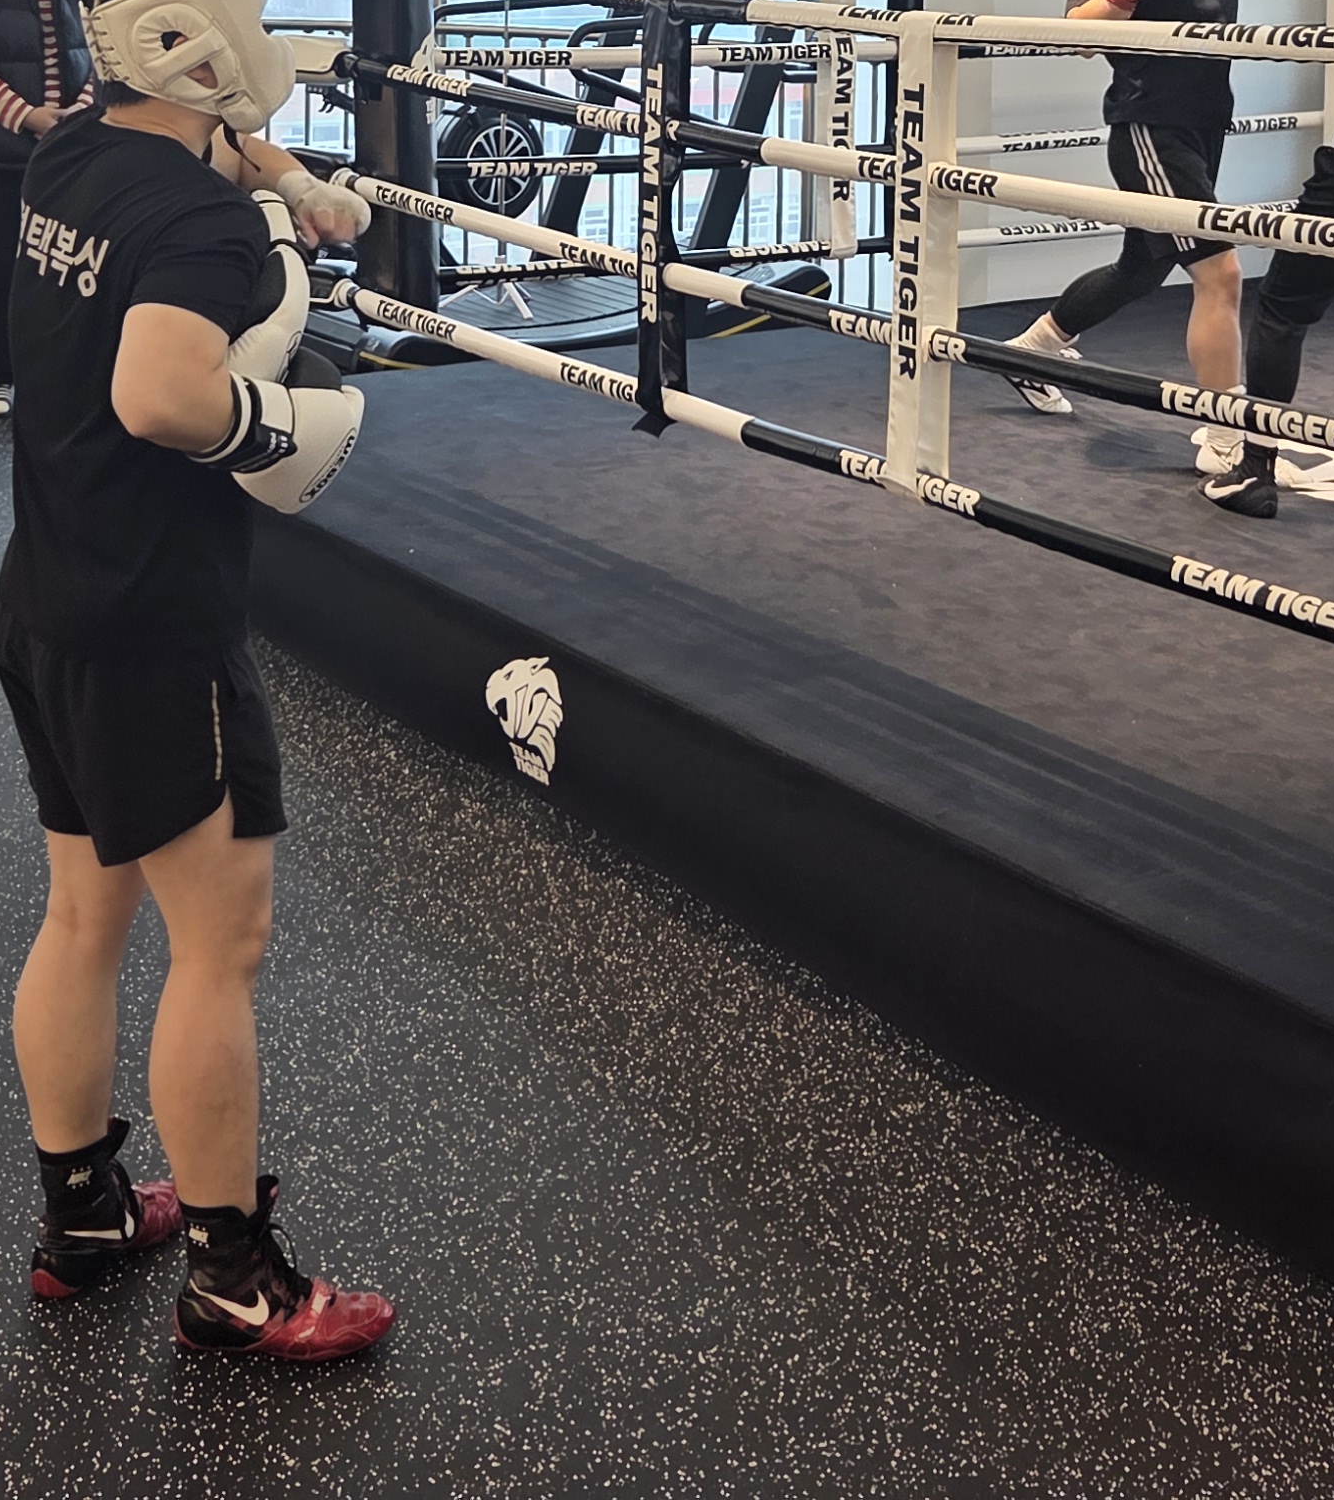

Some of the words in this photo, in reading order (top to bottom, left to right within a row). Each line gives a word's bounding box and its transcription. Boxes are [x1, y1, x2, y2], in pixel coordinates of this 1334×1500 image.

[442, 49, 505, 67] TEAM
[508, 49, 573, 67] TIGER
[718, 46, 773, 63] TEAM
[777, 43, 832, 61] TIGER
[833, 36, 854, 105] EAM
[386, 64, 430, 86] TEAM
[426, 72, 473, 97] TIGER
[576, 104, 627, 132] TEAM
[643, 63, 664, 186] TEAM
[1225, 120, 1252, 135] AM
[1255, 116, 1298, 133] TIGER
[467, 161, 533, 178] TEAM
[533, 161, 598, 177] TIGER
[857, 155, 896, 182] TEA
[899, 83, 925, 223] TEAM
[375, 184, 413, 215] TEAM
[414, 197, 455, 224] TIGER
[1196, 205, 1288, 240] TEAM
[559, 241, 607, 271] TEAM
[607, 258, 638, 278] TIG
[640, 195, 659, 324] TIGER
[789, 240, 831, 254] EAM
[376, 299, 416, 326] TEAM
[415, 311, 457, 342] TIGER
[898, 235, 920, 381] TIGER
[559, 361, 606, 395] TEAM
[607, 379, 638, 401] TIG
[1159, 381, 1250, 428] TEAM
[839, 449, 889, 485] TEA
[917, 473, 981, 517] IGER
[1170, 555, 1267, 606] TEAM
[509, 741, 544, 769] TEAM
[513, 755, 550, 786] TIGER
